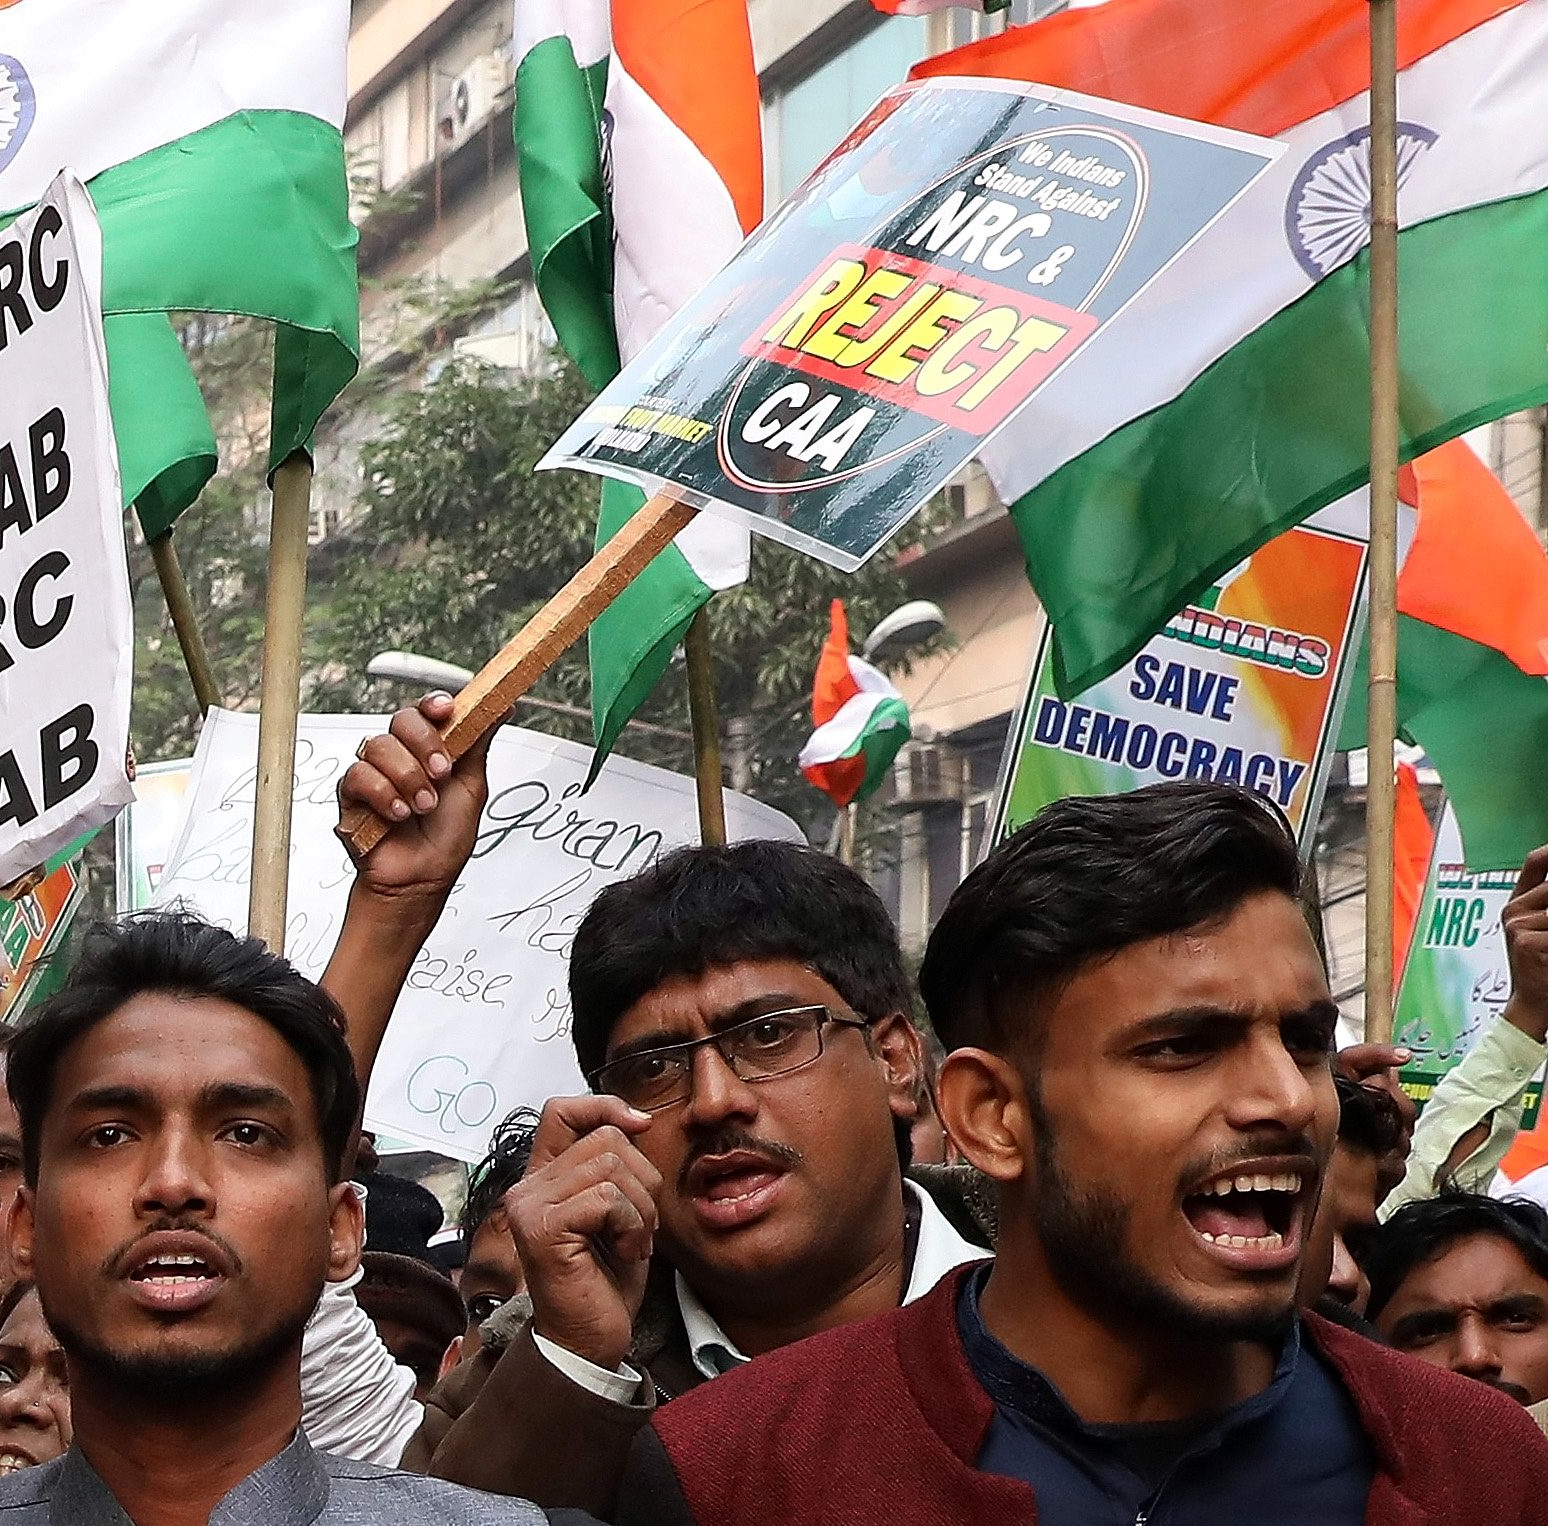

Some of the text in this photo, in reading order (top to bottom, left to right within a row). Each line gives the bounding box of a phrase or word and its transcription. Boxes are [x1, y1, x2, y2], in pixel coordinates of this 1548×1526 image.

[975, 163, 1121, 221] Stand Against
[1019, 142, 1126, 187] We Indians
[906, 191, 1074, 286] NRC &
[762, 259, 1070, 411] REJECT
[741, 382, 876, 471] CAA
[1164, 609, 1327, 675] NDIANS
[1131, 655, 1239, 721] SAVE
[1426, 898, 1484, 947] NRC
